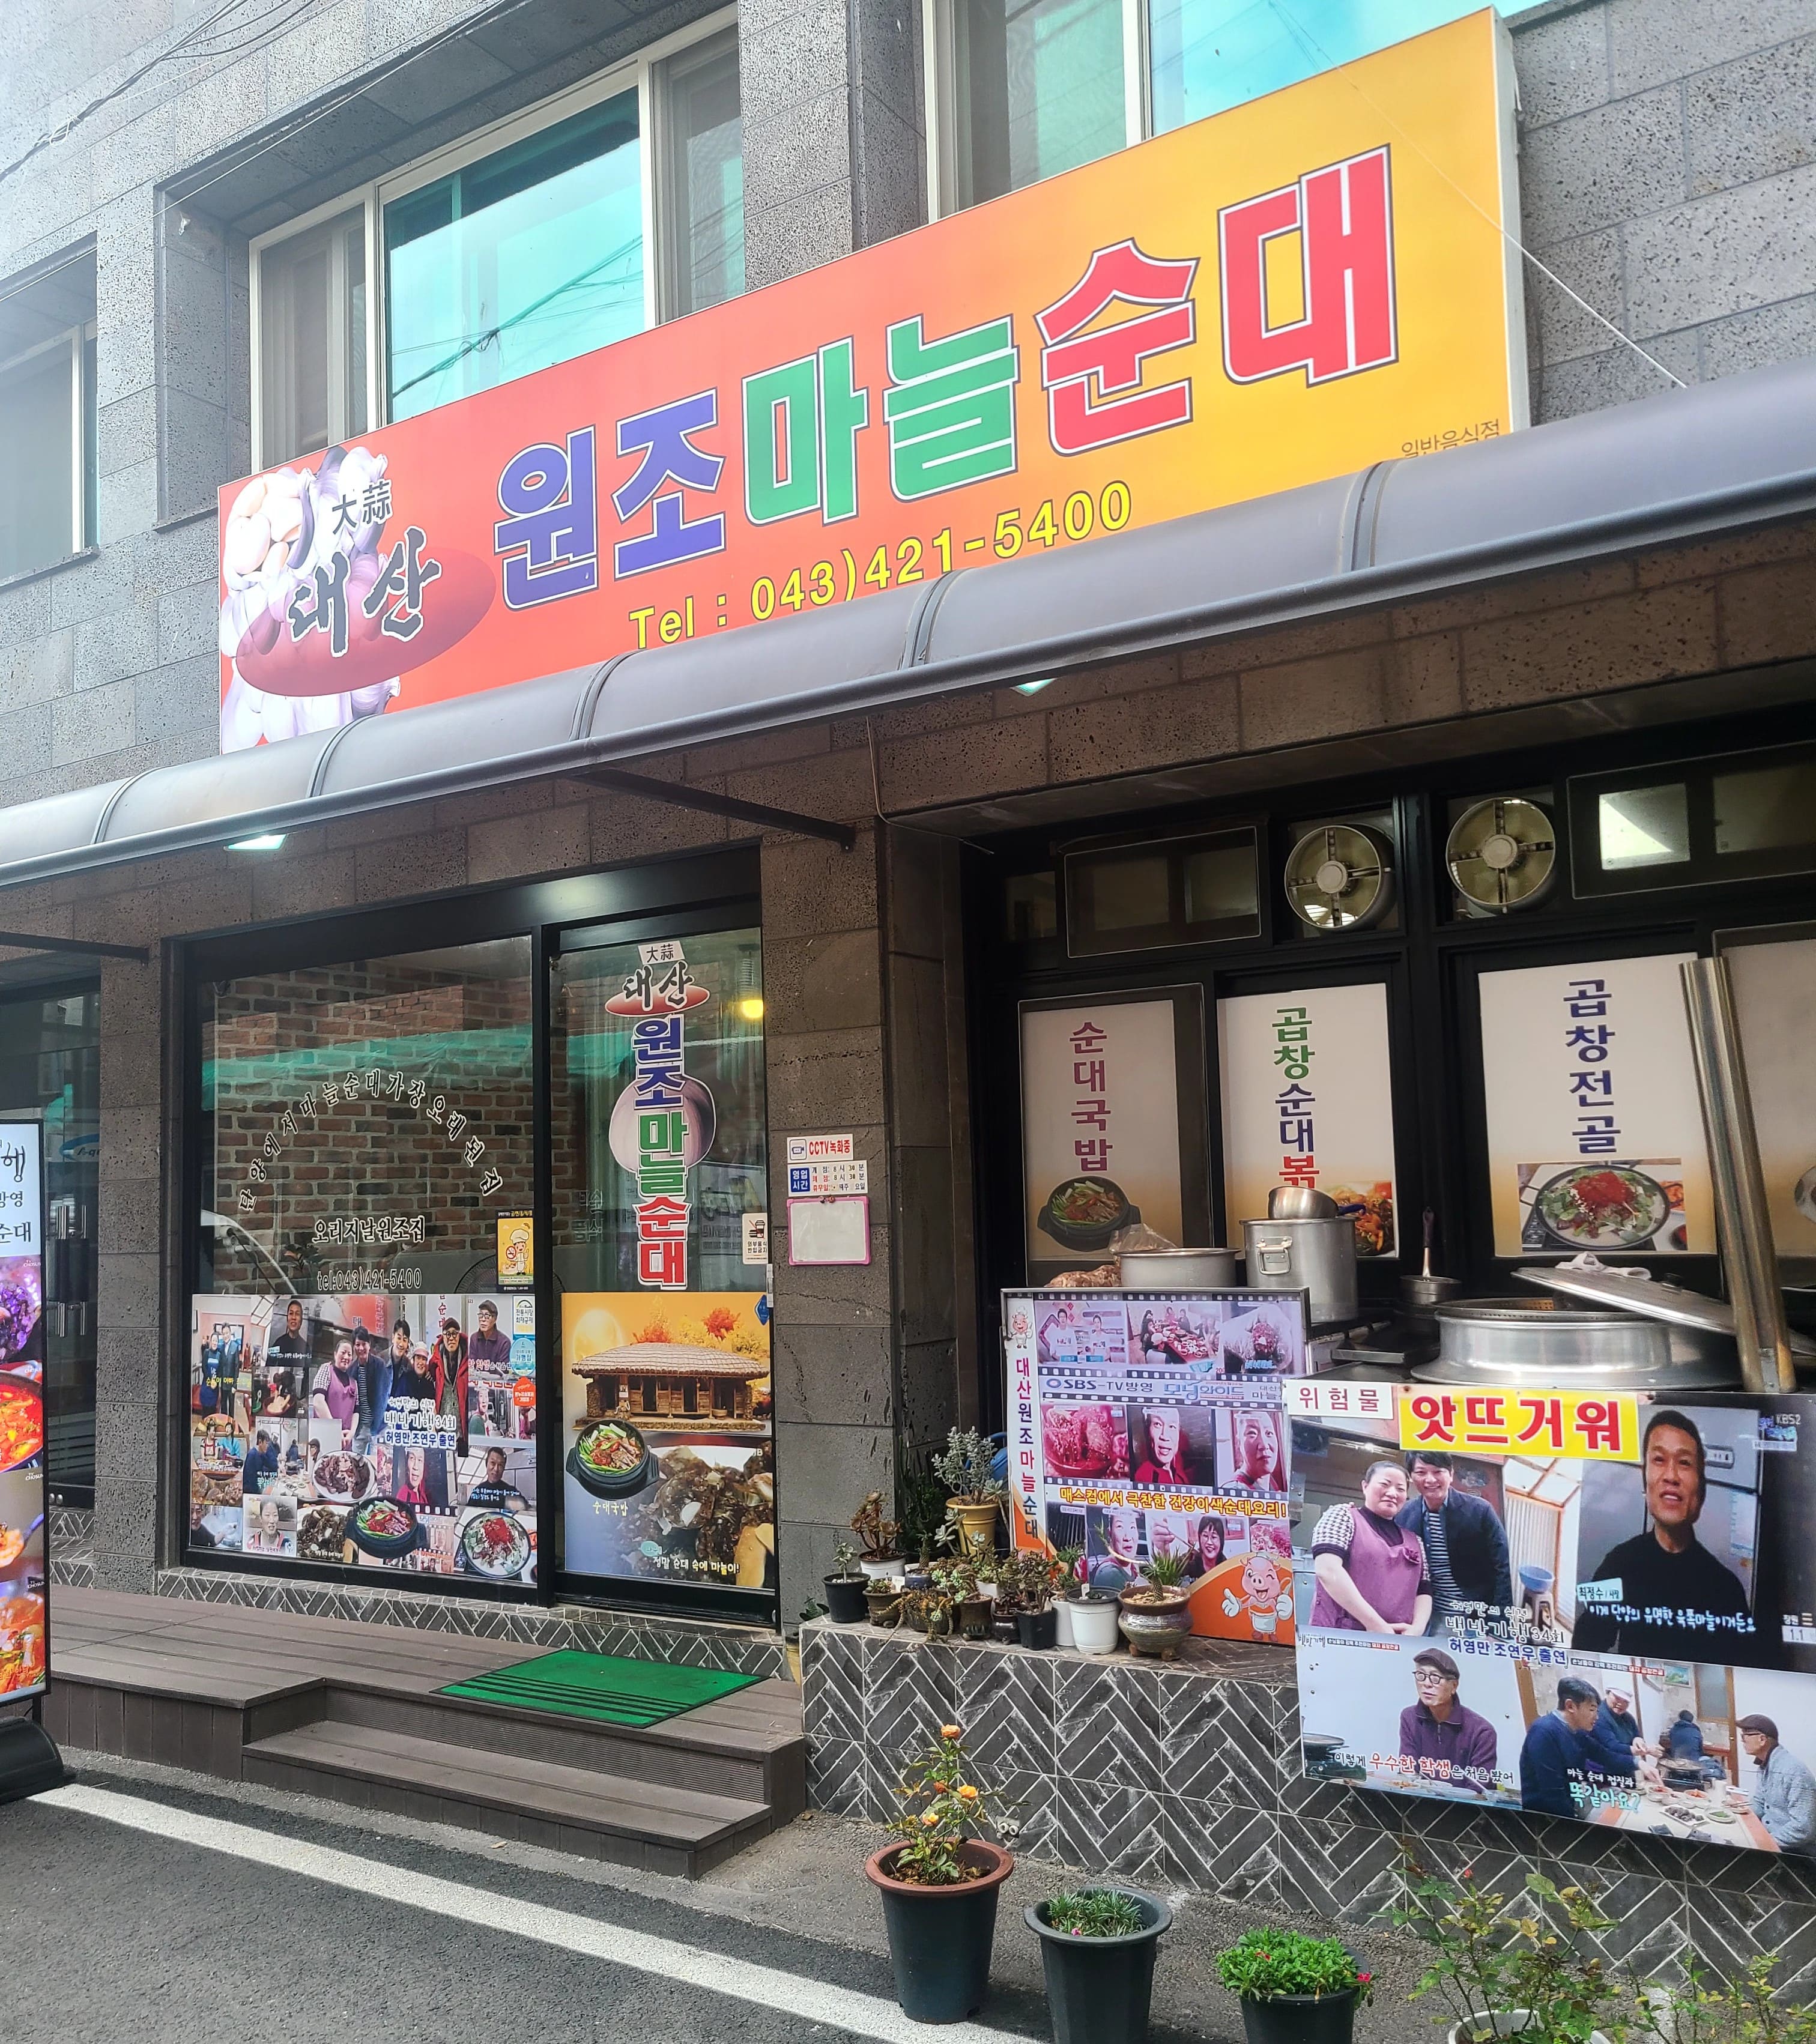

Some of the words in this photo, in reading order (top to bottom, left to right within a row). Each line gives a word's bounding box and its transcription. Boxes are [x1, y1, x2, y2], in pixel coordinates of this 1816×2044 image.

[332, 479, 392, 534] 大蒜
[629, 597, 695, 649] Tel
[751, 481, 1133, 621] 043)421-5400
[287, 526, 442, 657] 대산
[646, 943, 674, 963] 大蒜
[622, 960, 694, 1012] 대산
[1563, 979, 1621, 1154] 곱창전골
[1070, 1021, 1113, 1172] 순대국밥
[632, 1014, 691, 1290] 원조마늘순대
[809, 1140, 850, 1155] CCTV녹화중
[793, 1170, 808, 1179] 영업
[793, 1180, 808, 1190] 시간
[317, 1266, 423, 1291] tel:043)421-5400
[1300, 1387, 1379, 1412] 위험물
[1411, 1395, 1620, 1452] 앗뜨거워
[386, 1432, 410, 1445] 허영만
[412, 1433, 437, 1446] 조연우
[439, 1434, 455, 1447] 출연
[1015, 1357, 1039, 1540] 대산원조마늘순대
[1060, 1487, 1123, 1507] 매스컴에서
[1125, 1492, 1166, 1510] 극찬한
[1644, 1606, 1674, 1625] 유명한
[1445, 1616, 1530, 1643] 백반기행
[1531, 1626, 1564, 1643] 34회
[1449, 1637, 1490, 1656] 허영만
[1494, 1642, 1535, 1661] 조연우
[1539, 1647, 1566, 1665] 출연
[1334, 1752, 1366, 1767] 이렇게
[1369, 1752, 1415, 1773] 우수한
[1418, 1757, 1463, 1778] 학생은
[1465, 1767, 1489, 1781] 처음
[1491, 1770, 1514, 1784] 봤어
[1567, 1768, 1584, 1780] 마늘
[1587, 1771, 1604, 1782] 순대
[1607, 1774, 1634, 1788] 껍질과
